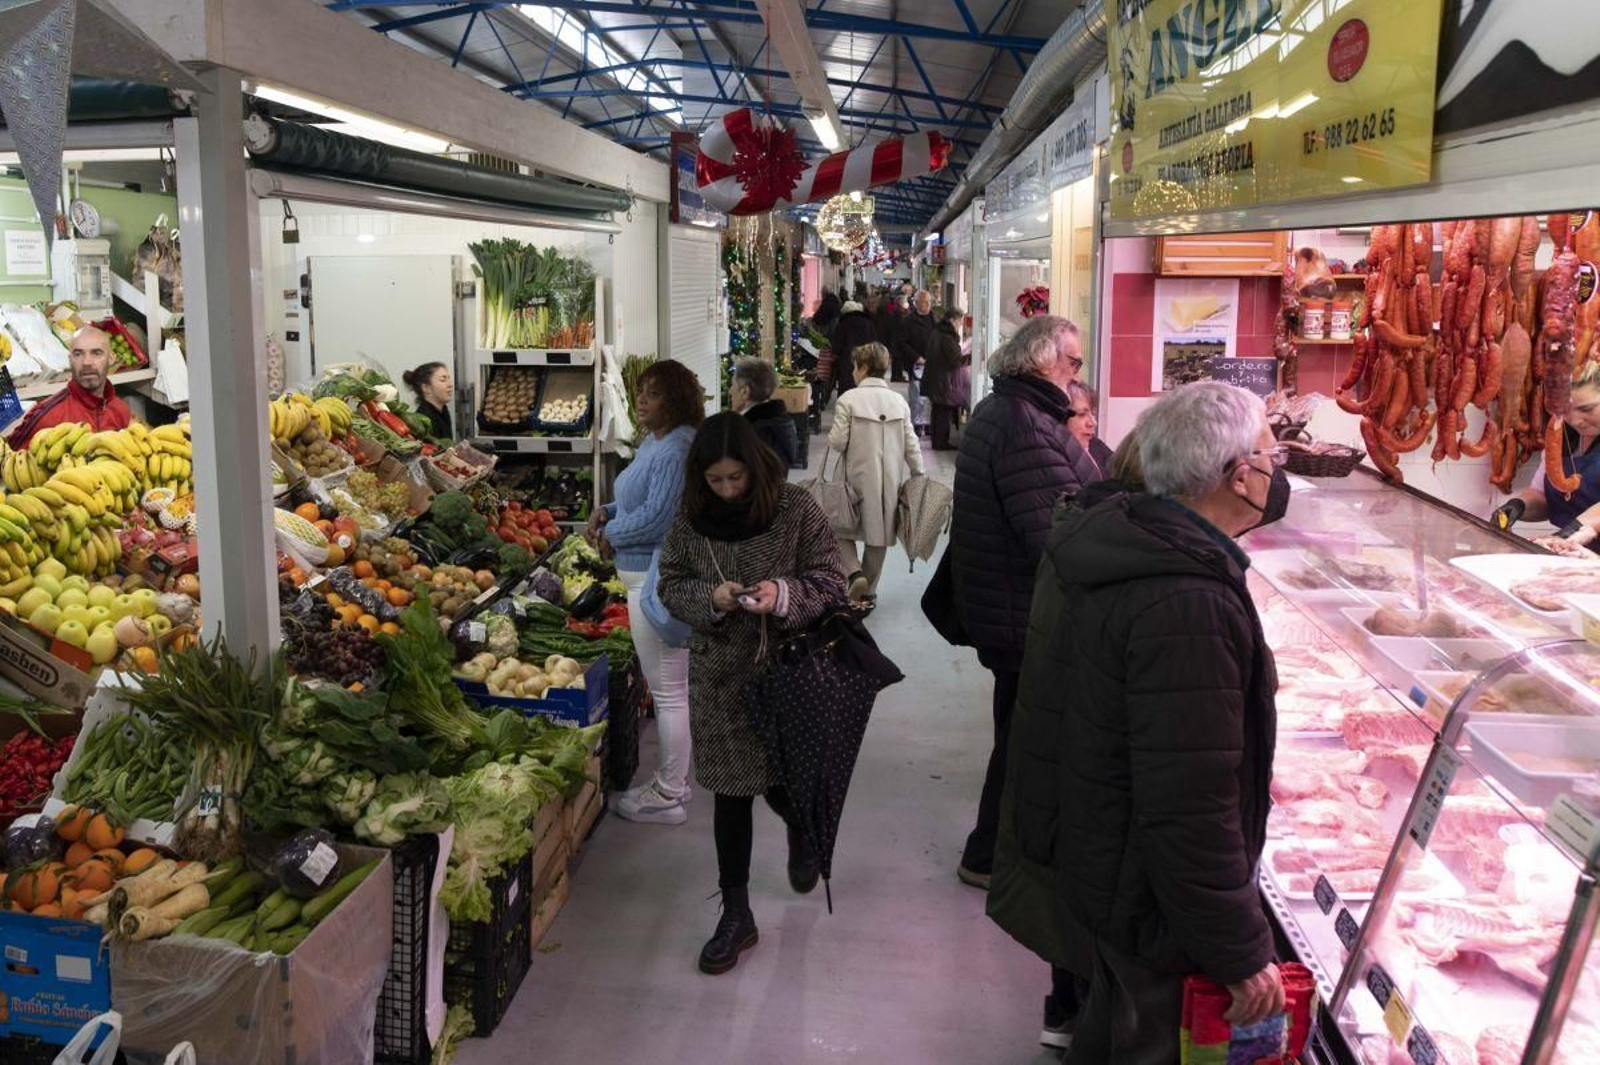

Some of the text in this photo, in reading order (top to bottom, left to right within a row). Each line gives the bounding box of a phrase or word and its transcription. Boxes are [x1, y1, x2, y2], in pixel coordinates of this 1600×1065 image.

[1204, 90, 1252, 133] GALLEGA
[1324, 122, 1342, 150] 988
[1345, 117, 1358, 145] 22
[1361, 112, 1376, 141] 62
[1379, 106, 1395, 137] 65
